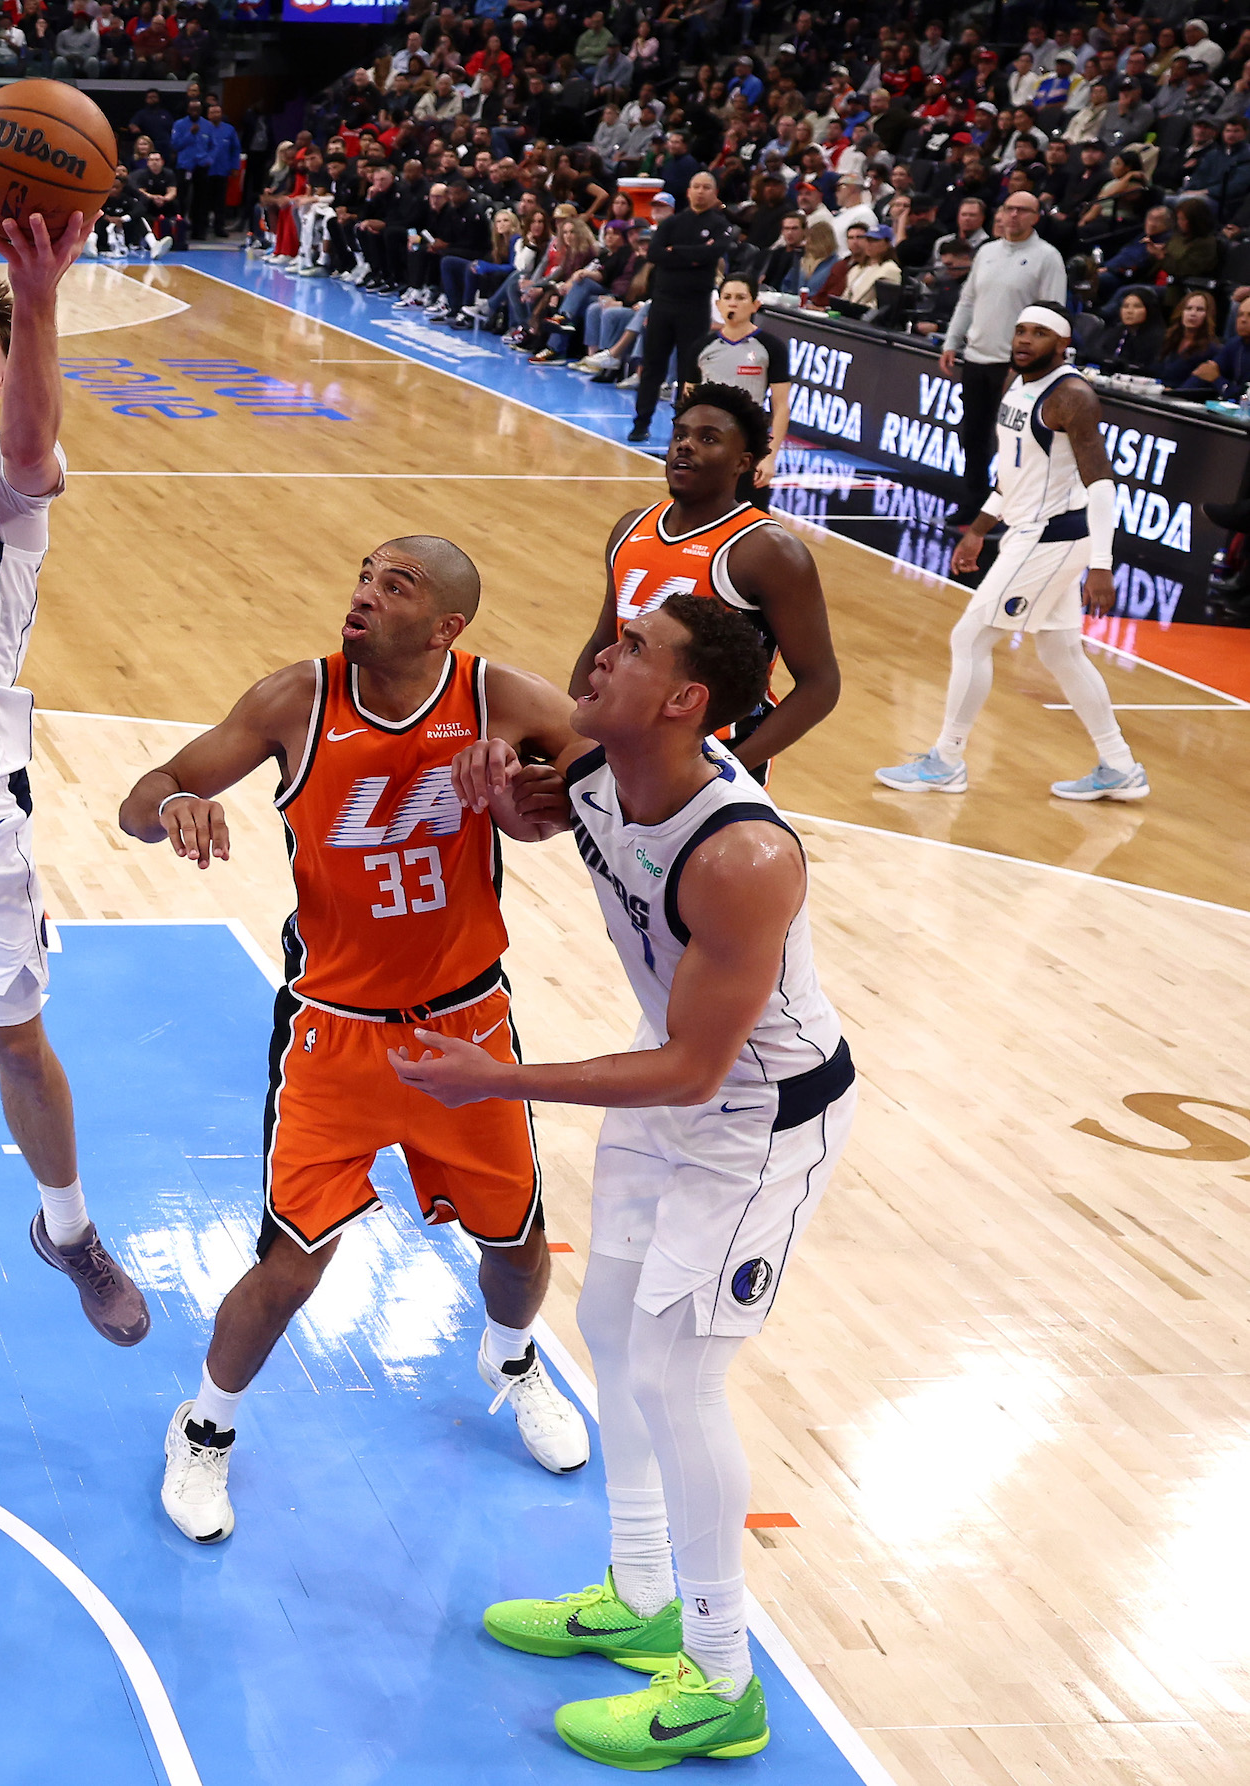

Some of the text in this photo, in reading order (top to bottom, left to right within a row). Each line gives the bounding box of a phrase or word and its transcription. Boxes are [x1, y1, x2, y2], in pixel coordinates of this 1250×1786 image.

[788, 337, 853, 391] VISIT
[919, 372, 965, 426] VIS
[879, 411, 966, 477] RWAN
[1113, 482, 1193, 553] NDA
[682, 547, 710, 557] RWANDA
[426, 728, 472, 739] RWANDA
[435, 722, 461, 730] VISIT
[324, 765, 463, 848] LA
[363, 845, 447, 919] 33
[636, 847, 664, 879] chime
